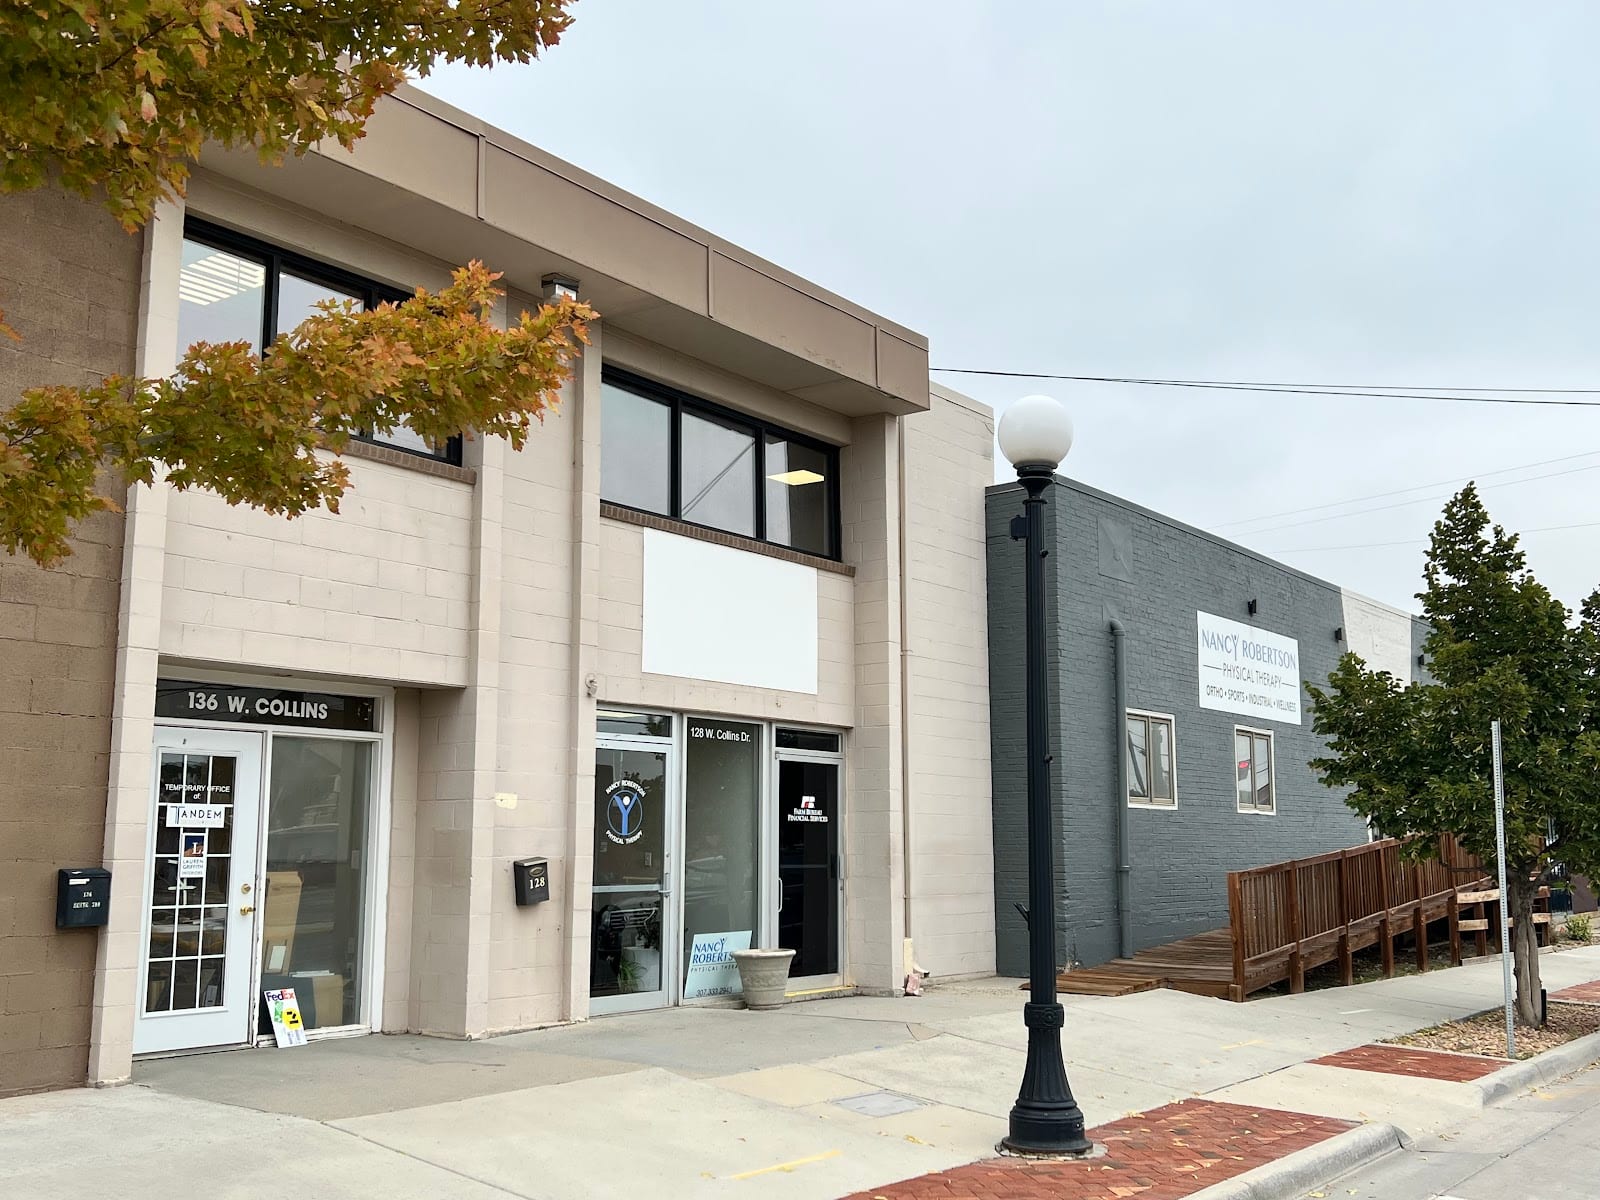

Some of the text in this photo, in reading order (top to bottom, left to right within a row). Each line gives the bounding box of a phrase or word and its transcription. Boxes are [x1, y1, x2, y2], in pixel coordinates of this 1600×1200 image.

[1201, 628, 1297, 670] NANCY ROBERTSON
[1223, 662, 1282, 688] PHYSICAL THERAPY
[187, 691, 328, 720] 136 W. COLLINS
[1206, 684, 1297, 713] ORTHO SPORTS INDUSTRIAL WELLNESS
[690, 726, 751, 742] 128 W. Collins Dr.
[165, 783, 206, 791] TEMPORARY
[605, 779, 647, 797] NANCY ROBERTSON
[170, 805, 222, 825] TANDEM
[605, 829, 643, 845] PHYSICAL THERAPY
[530, 877, 545, 889] 128
[694, 937, 727, 953] NANCY
[692, 952, 735, 964] ROBERTS
[265, 990, 295, 1002] FedEx
